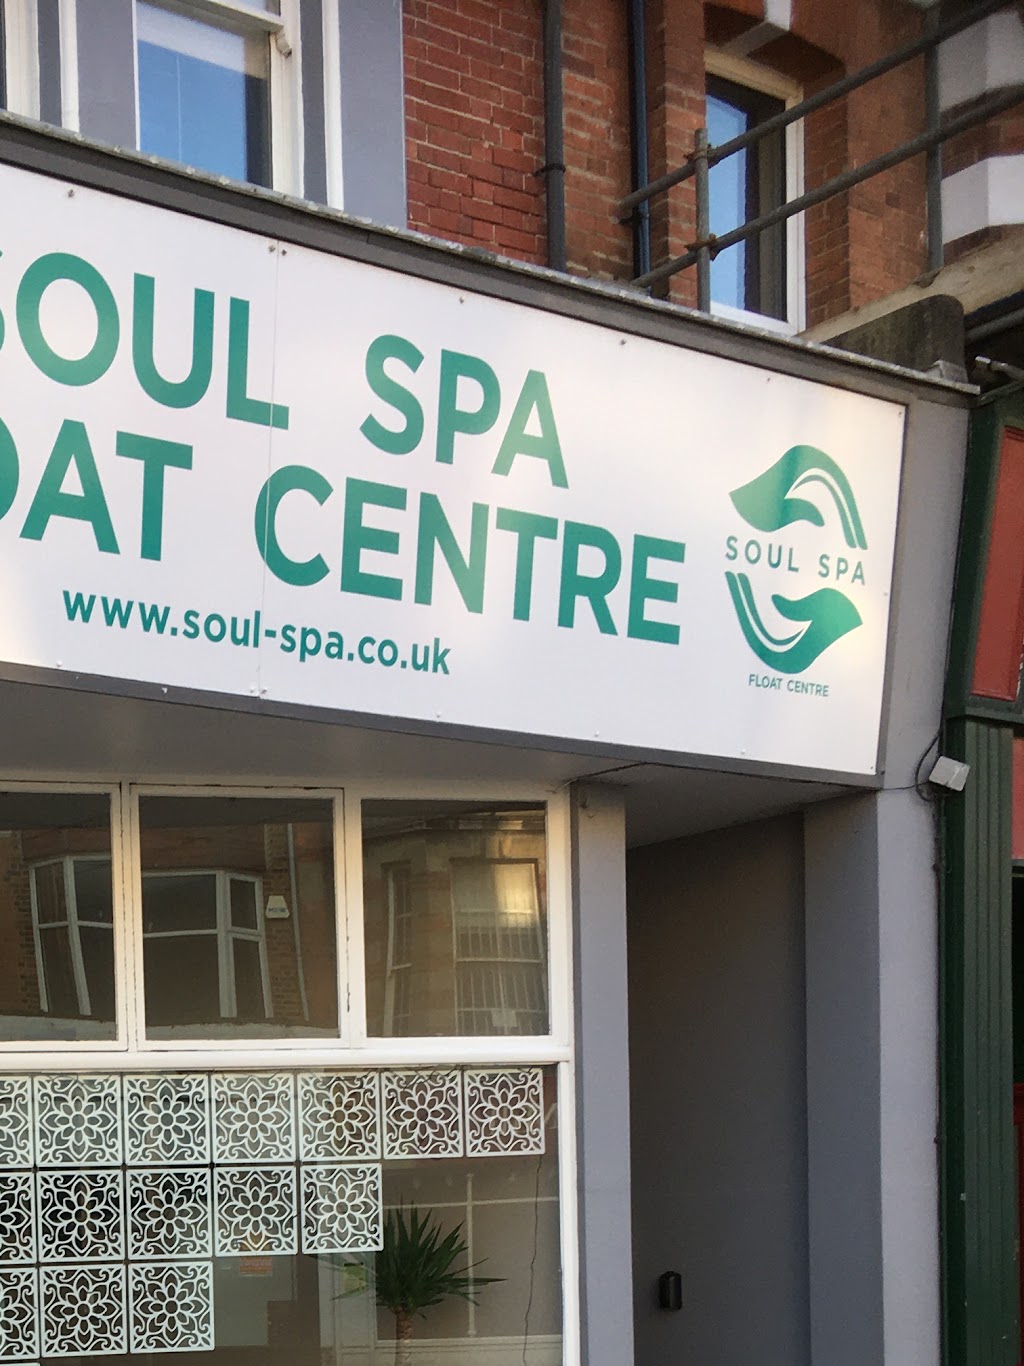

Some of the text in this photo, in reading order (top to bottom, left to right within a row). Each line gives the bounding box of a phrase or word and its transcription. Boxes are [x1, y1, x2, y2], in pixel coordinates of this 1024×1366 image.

[359, 334, 569, 489] SPA
[254, 464, 687, 646] CENTRE
[725, 535, 866, 585] SOUL SPA
[63, 590, 452, 676] www.soul-spa.co.uk
[748, 673, 829, 697] FLOAT CENTRE
